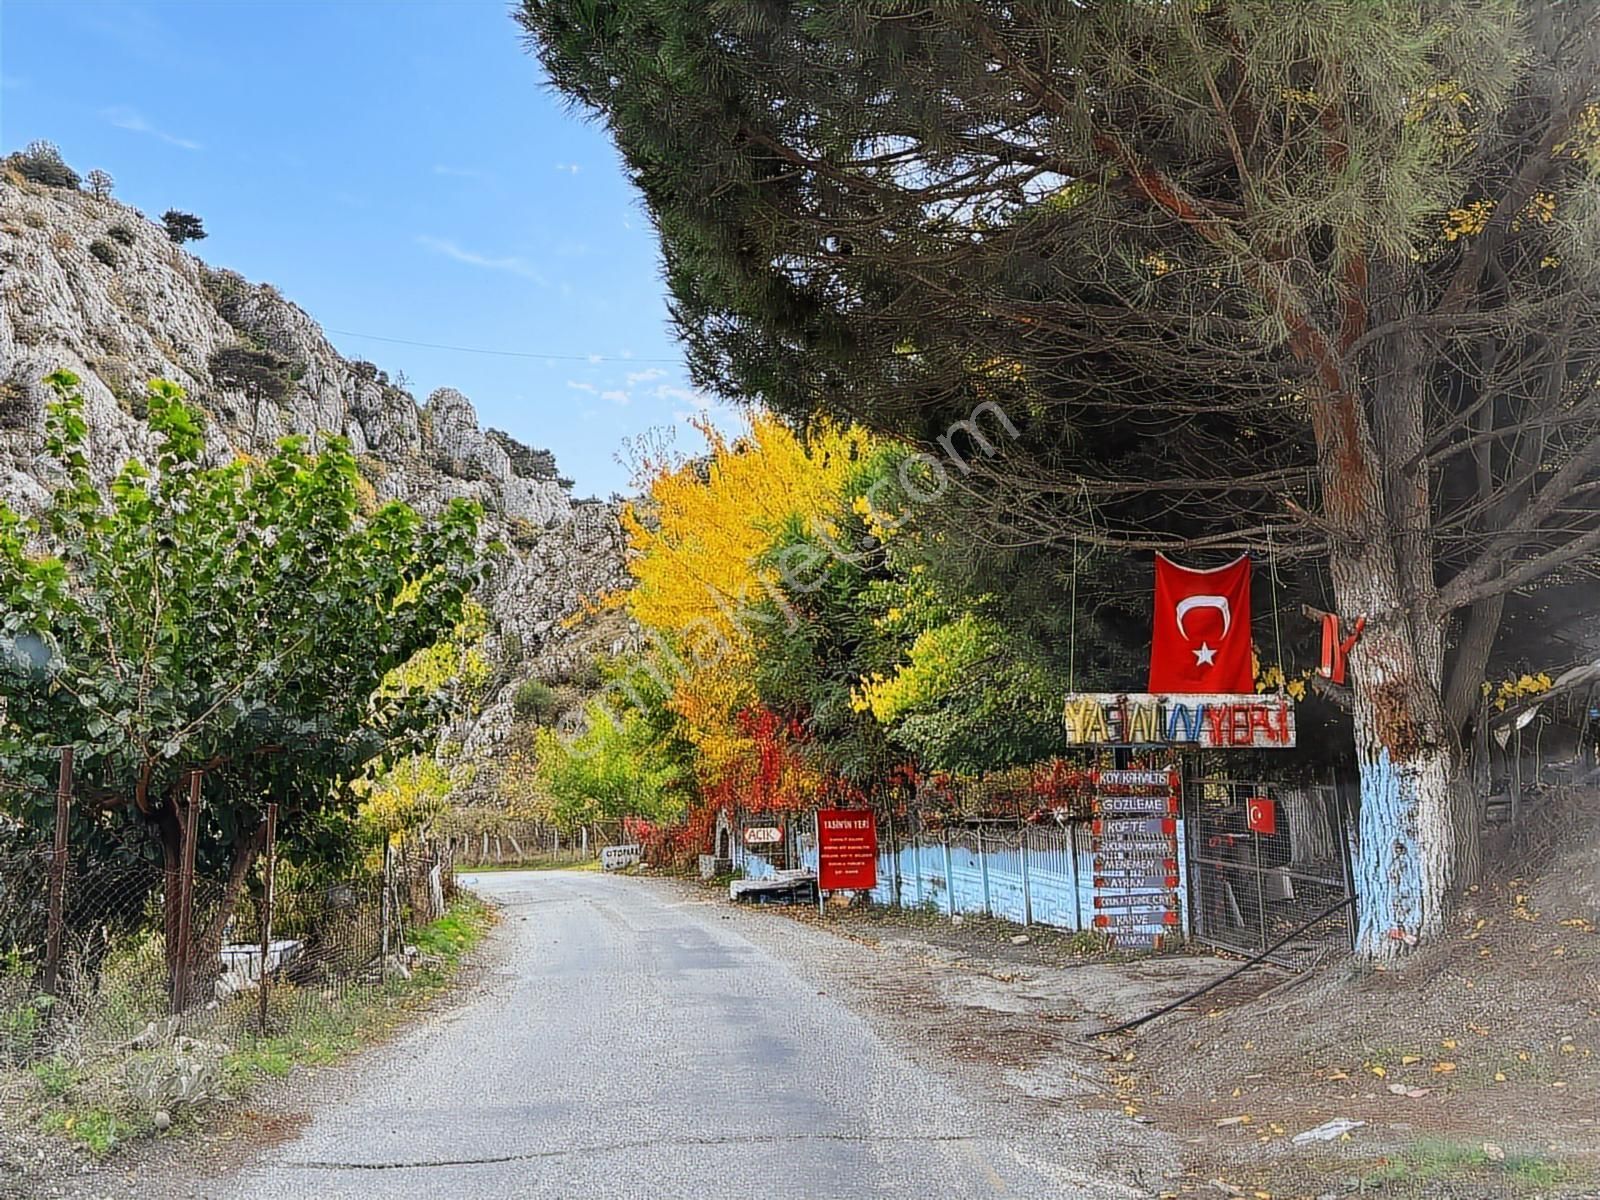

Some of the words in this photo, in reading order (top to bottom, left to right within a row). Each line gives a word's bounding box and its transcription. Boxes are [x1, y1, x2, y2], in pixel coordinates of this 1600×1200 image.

[1104, 858, 1155, 870] MENEMEN
[1110, 878, 1145, 888] AYRAN
[1116, 914, 1150, 926] KAHVE
